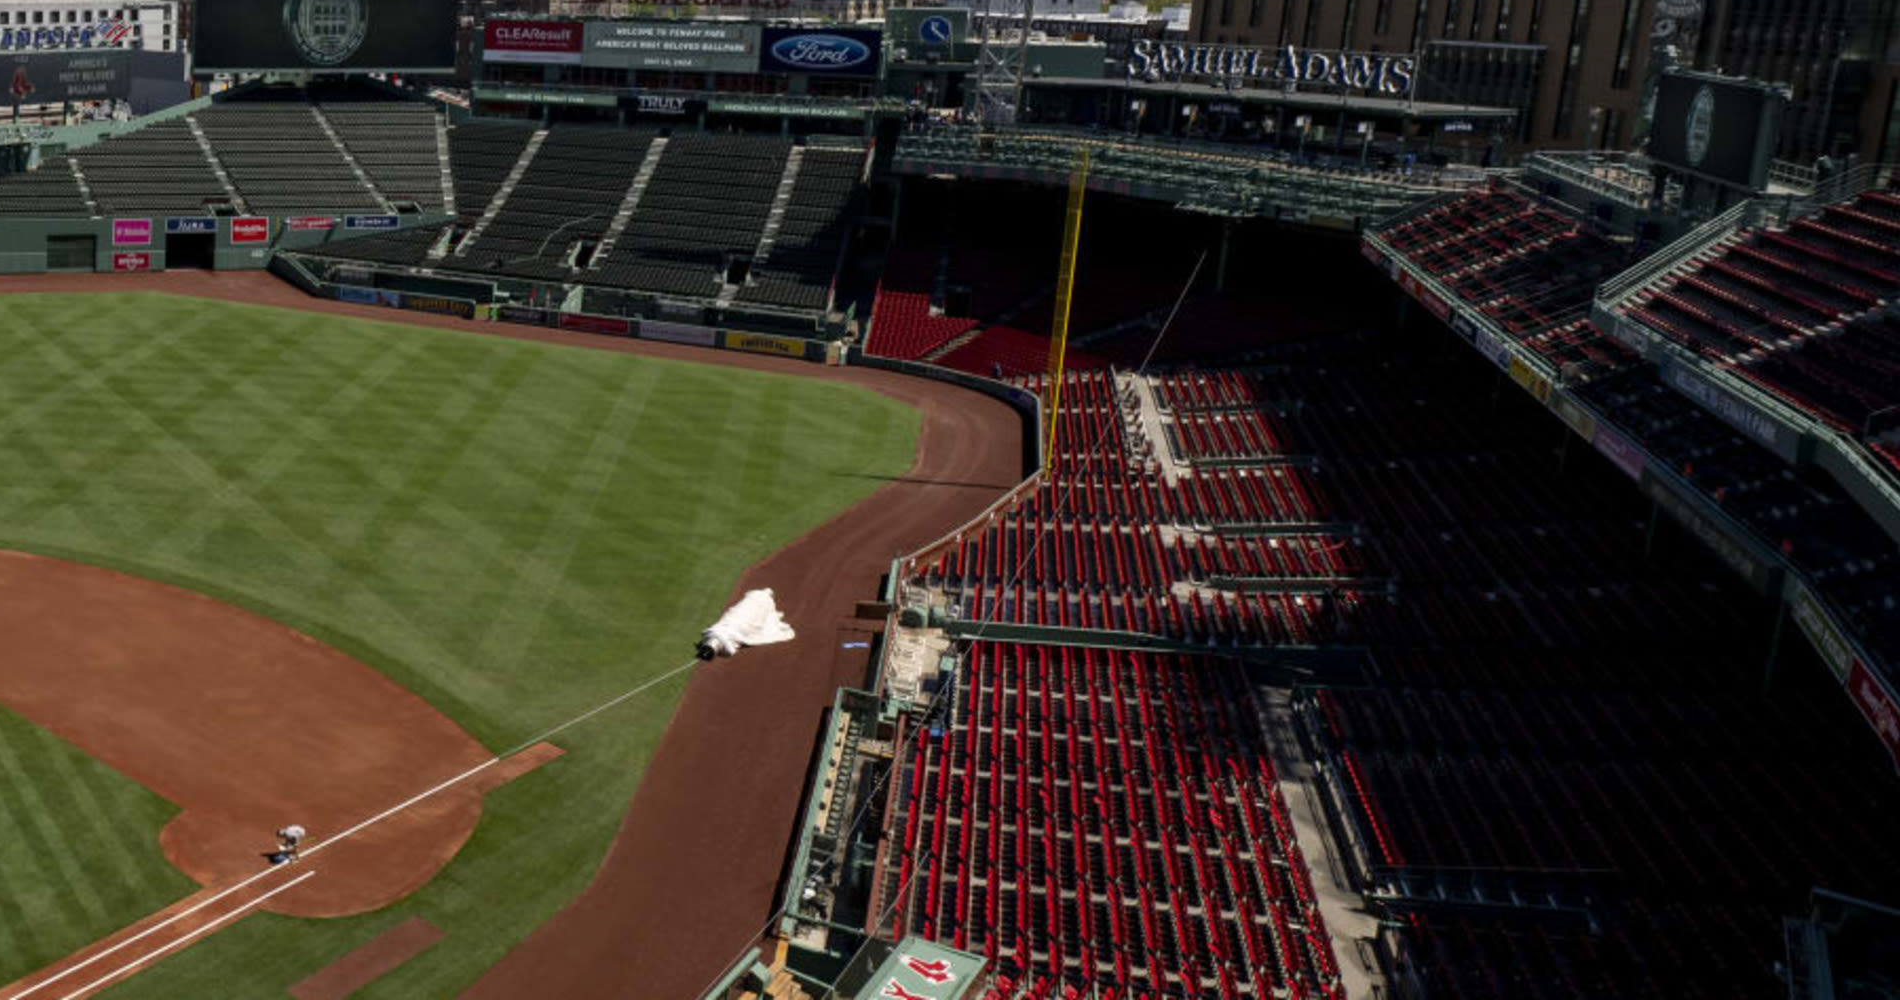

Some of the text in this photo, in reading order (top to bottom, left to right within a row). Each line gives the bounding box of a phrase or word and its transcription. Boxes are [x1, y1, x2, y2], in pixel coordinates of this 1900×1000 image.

[1, 27, 92, 48] AMERICA
[495, 27, 572, 41] CLEAResult
[788, 34, 847, 65] Ford
[1127, 40, 1415, 94] SAMUEL ADAMS
[637, 94, 687, 109] TRULY
